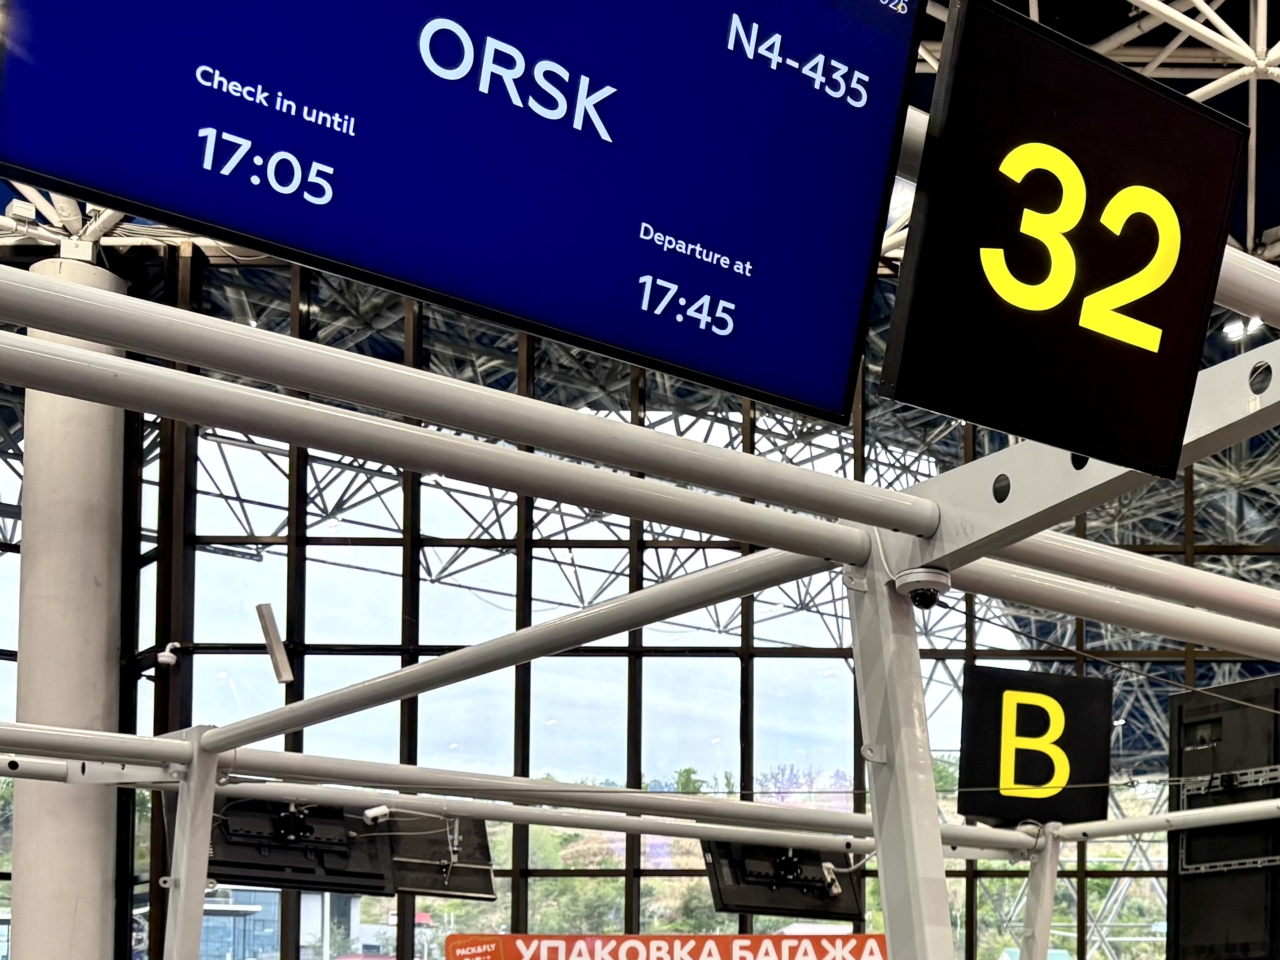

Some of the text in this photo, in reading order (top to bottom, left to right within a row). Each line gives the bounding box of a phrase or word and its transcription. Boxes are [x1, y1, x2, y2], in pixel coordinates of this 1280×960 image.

[419, 17, 618, 143] ORSK
[728, 13, 870, 108] N4-435
[195, 65, 357, 138] Check in until
[197, 126, 335, 206] 17:05
[639, 222, 754, 278] Departure at
[979, 142, 1182, 354] 32
[638, 275, 736, 337] 17:45
[999, 690, 1071, 799] B
[455, 942, 496, 957] PACK&FLY
